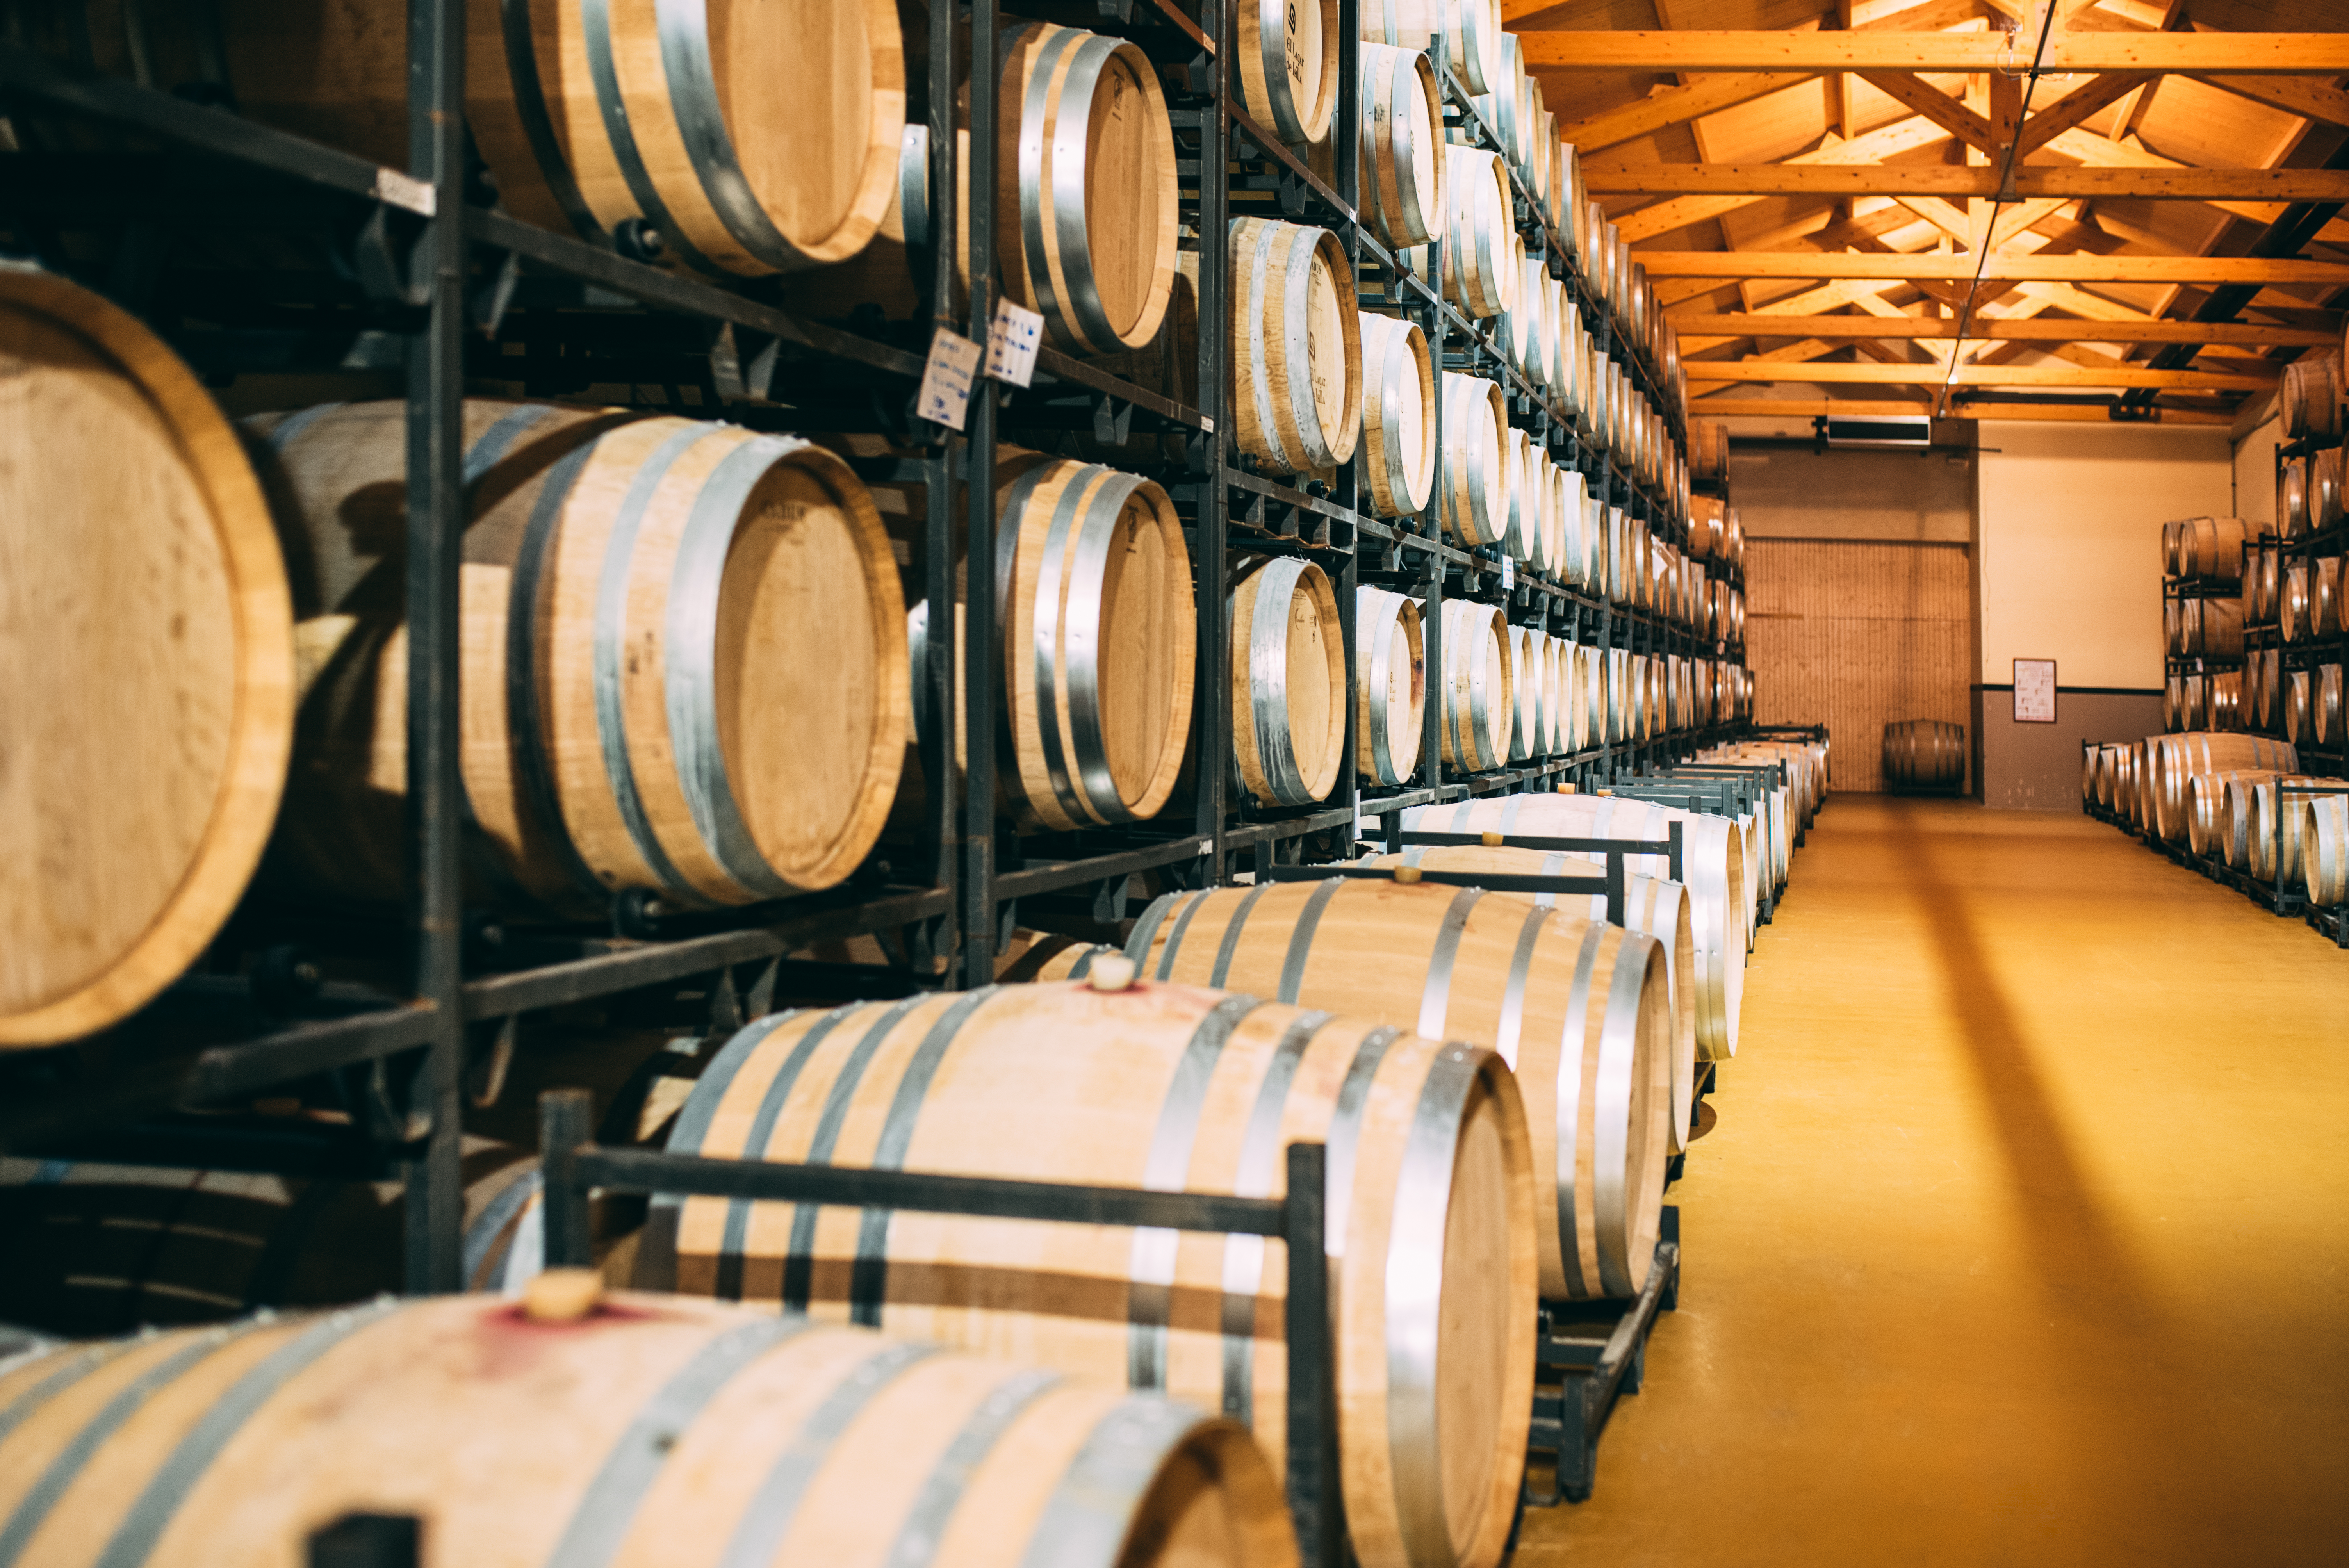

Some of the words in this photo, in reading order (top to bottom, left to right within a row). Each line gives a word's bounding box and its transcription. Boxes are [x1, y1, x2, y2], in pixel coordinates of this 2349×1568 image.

[1287, 37, 1292, 53] El
[1293, 42, 1304, 67] Lagar
[1287, 56, 1292, 72] de
[1314, 369, 1326, 389] Lagar
